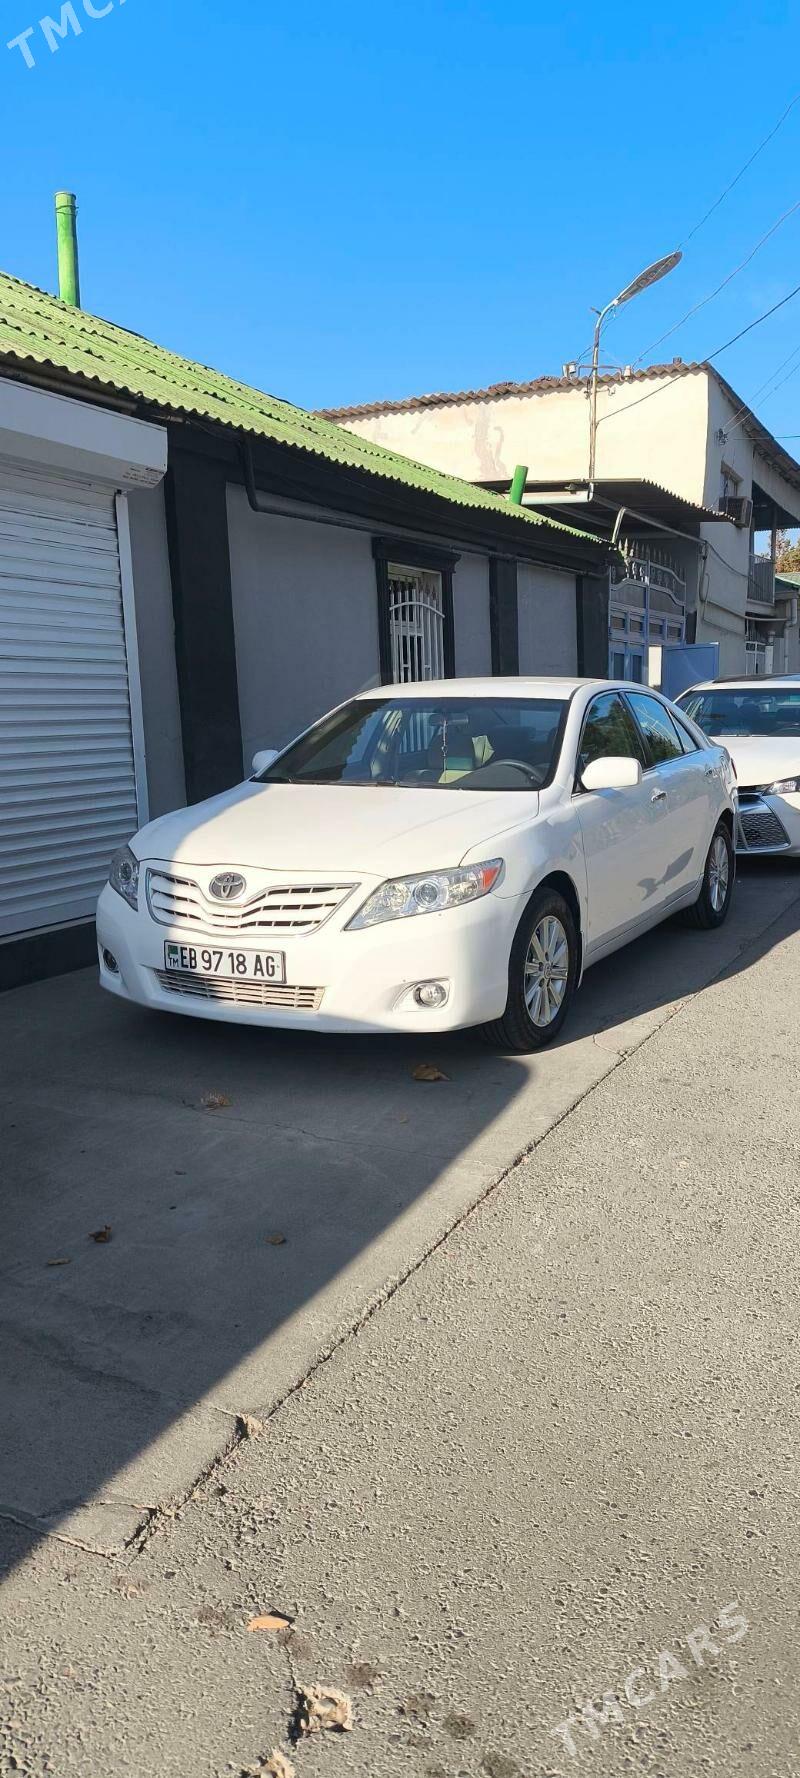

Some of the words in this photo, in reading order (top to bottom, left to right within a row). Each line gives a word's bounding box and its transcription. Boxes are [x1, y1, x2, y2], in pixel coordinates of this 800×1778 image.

[168, 957, 179, 968] TM
[180, 946, 198, 970] EB
[201, 949, 223, 972] 97
[228, 952, 247, 975] 18
[253, 954, 276, 977] AG
